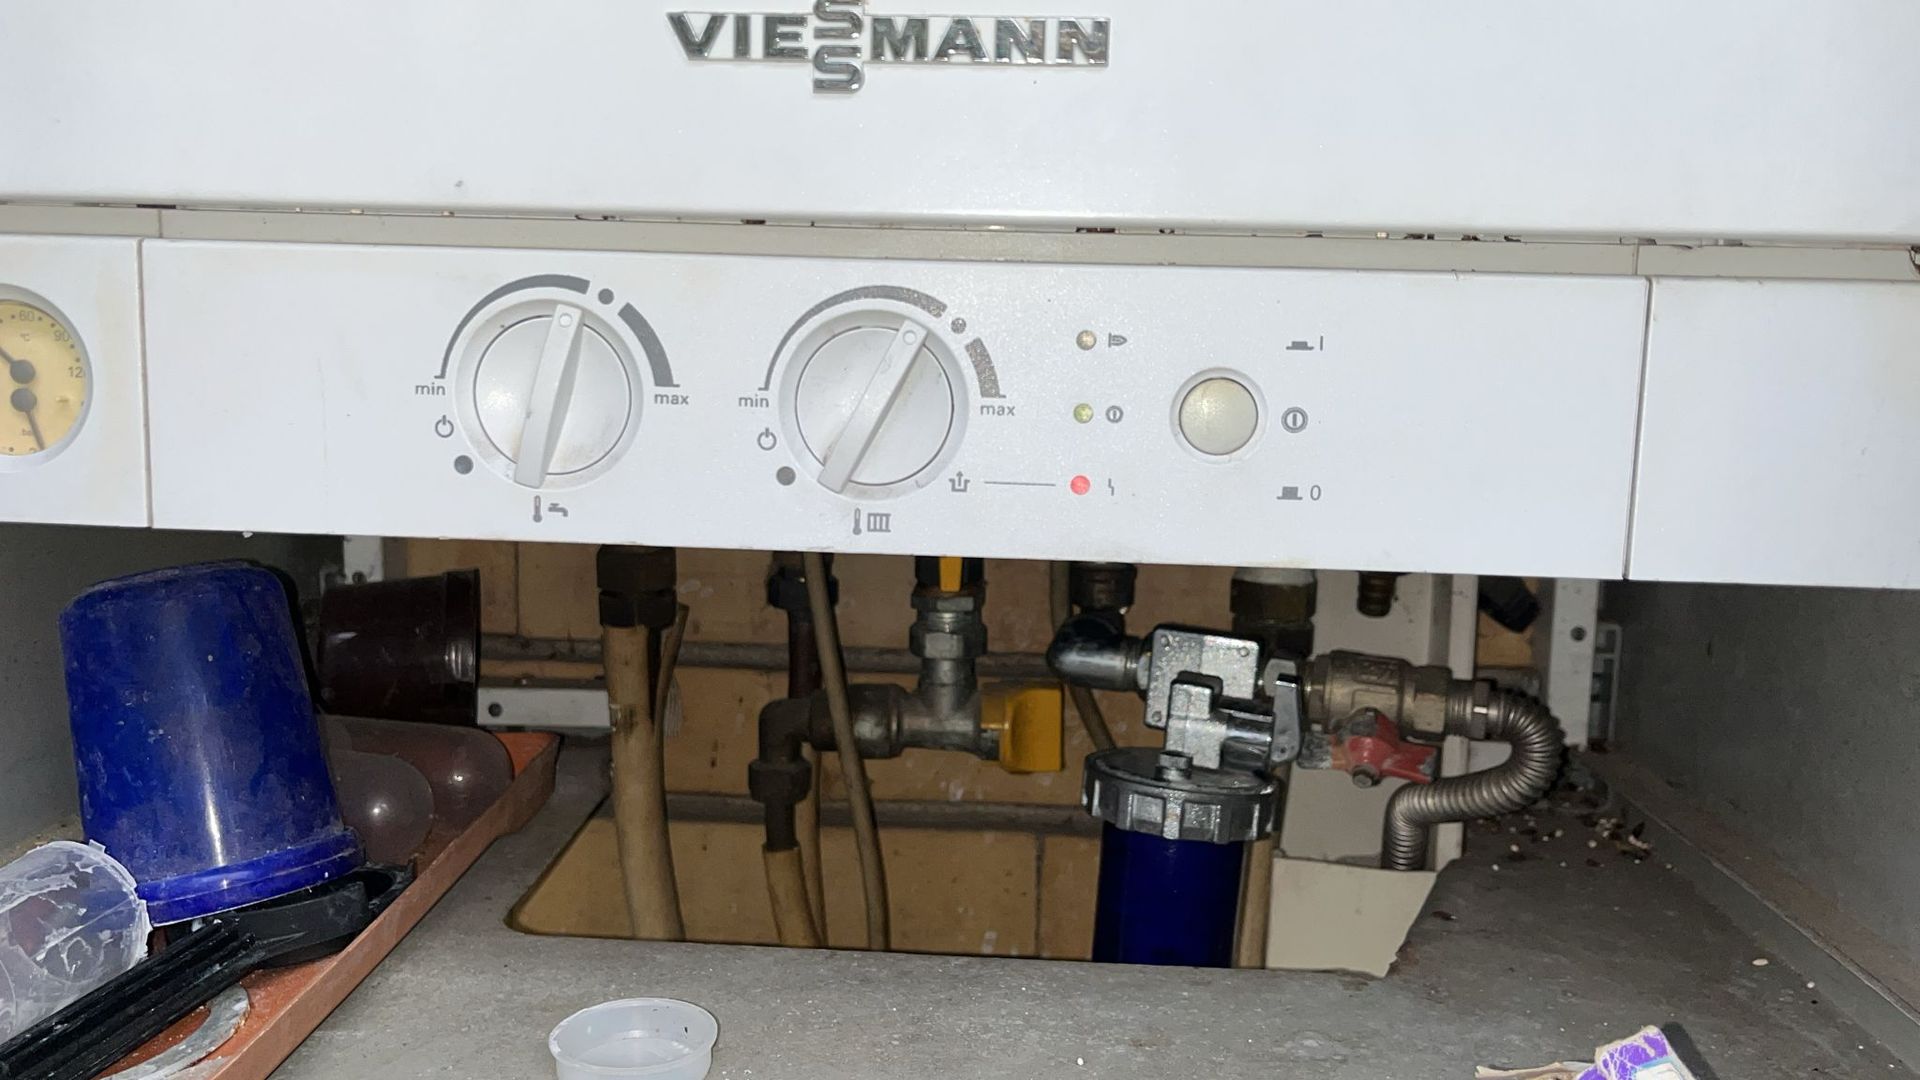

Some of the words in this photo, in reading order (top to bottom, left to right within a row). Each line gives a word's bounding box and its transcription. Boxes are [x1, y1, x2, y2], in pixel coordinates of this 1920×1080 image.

[667, 0, 1111, 94] VIESSMANN
[19, 311, 35, 322] 60
[54, 329, 70, 342] 90
[68, 366, 86, 379] 12
[415, 382, 446, 396] min
[653, 392, 690, 406] max
[738, 395, 770, 408] min
[980, 404, 1016, 417] max
[1309, 484, 1322, 501] 0
